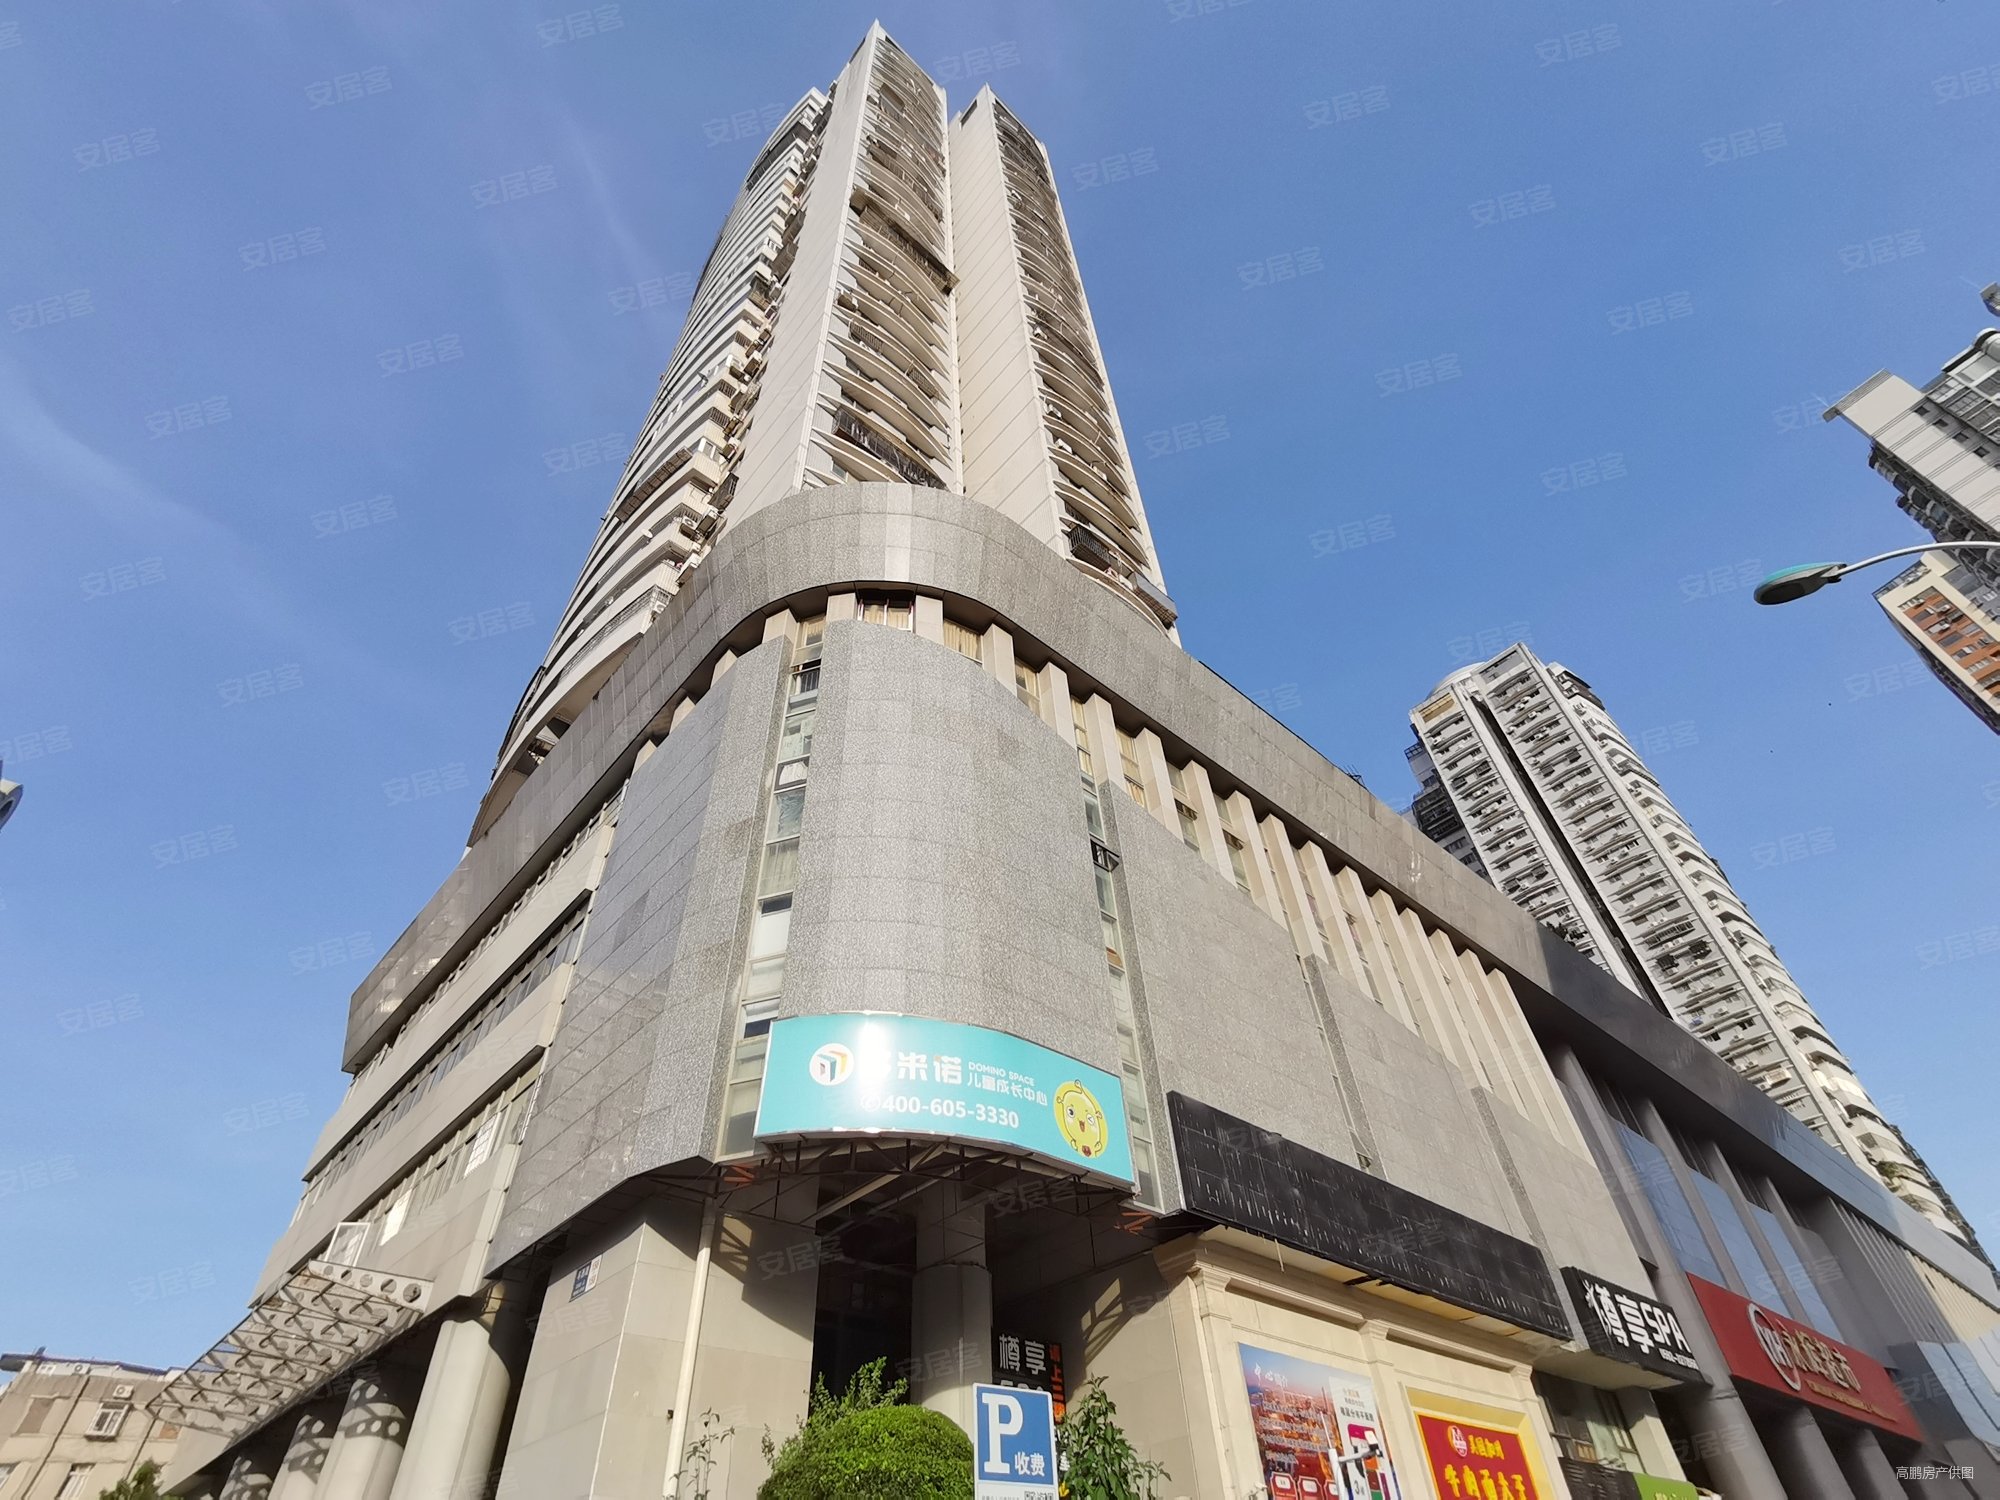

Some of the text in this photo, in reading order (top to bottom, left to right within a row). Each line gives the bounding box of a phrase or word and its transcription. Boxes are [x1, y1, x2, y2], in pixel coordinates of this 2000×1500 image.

[967, 1073, 1047, 1106] 儿童成长中心
[968, 1061, 1035, 1087] DOMINO SPACE
[882, 1095, 1019, 1129] 400-605-3330
[982, 1392, 1024, 1474] P
[1014, 1451, 1046, 1477] 收费
